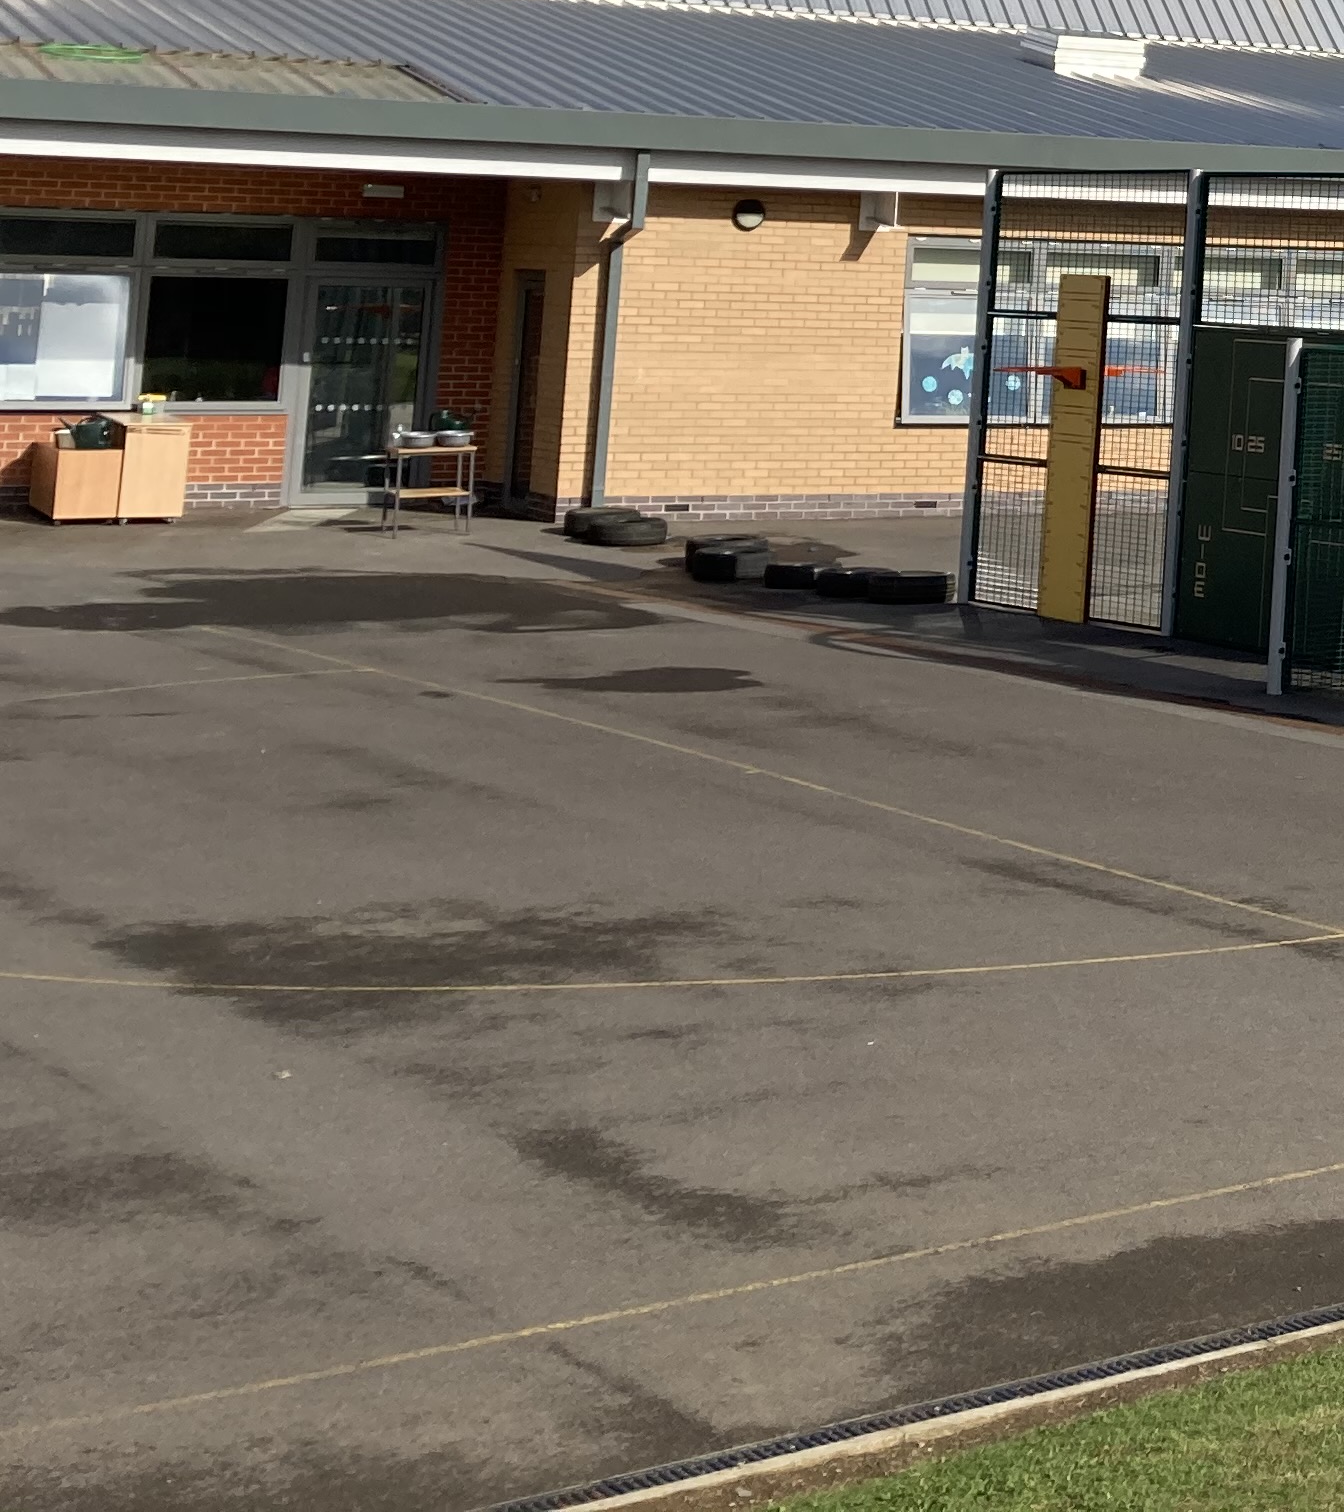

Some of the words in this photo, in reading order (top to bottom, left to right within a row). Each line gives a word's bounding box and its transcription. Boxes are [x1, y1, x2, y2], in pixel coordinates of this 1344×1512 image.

[1231, 433, 1244, 452] 10
[1247, 435, 1266, 454] 25
[1193, 523, 1212, 599] WIDE
